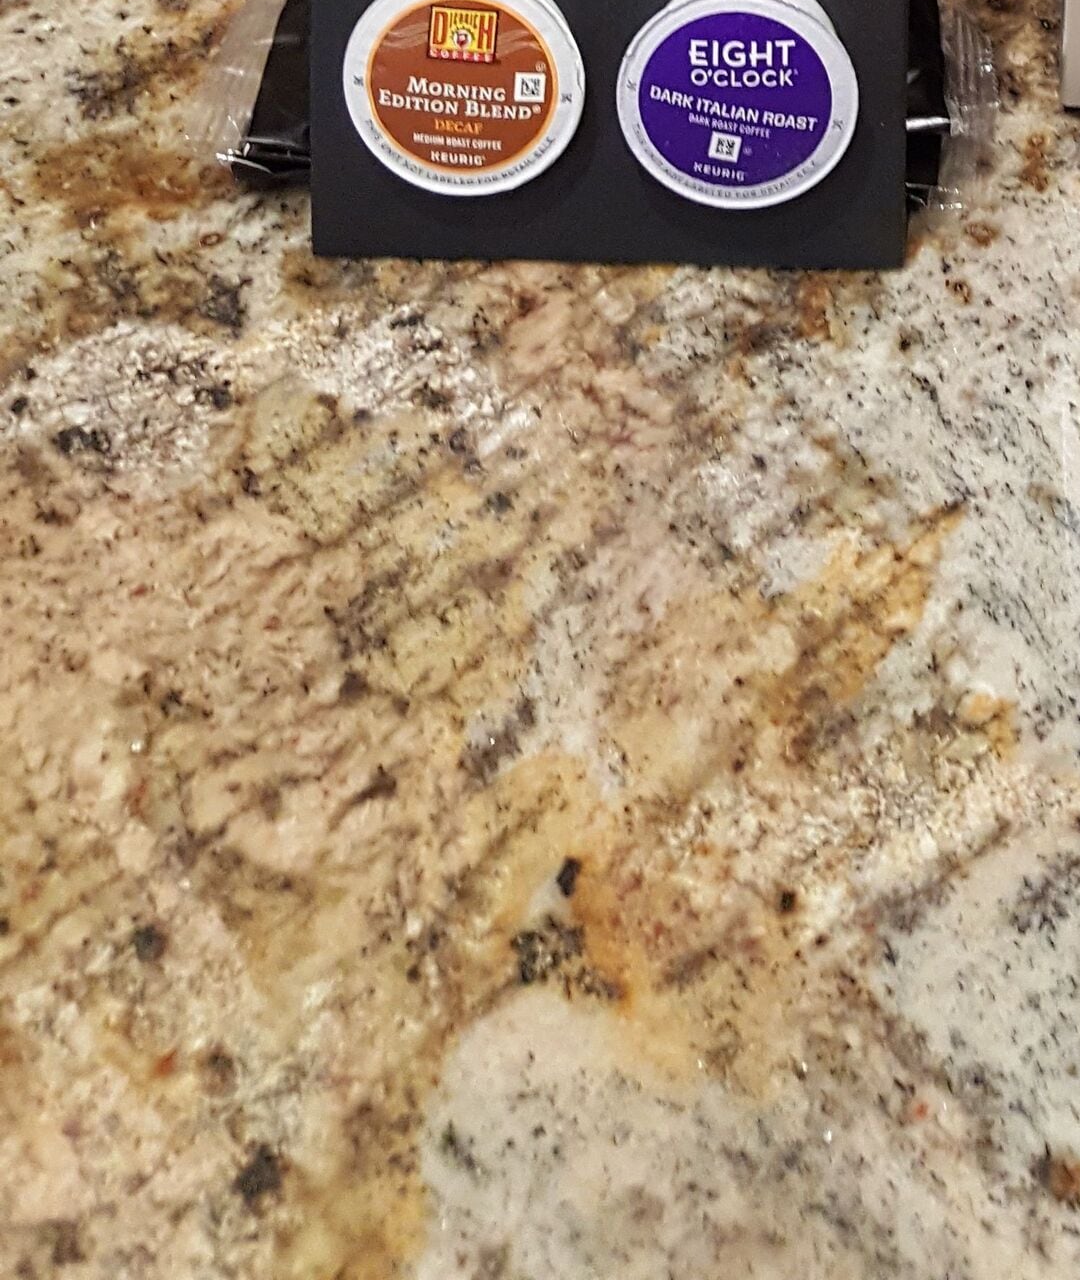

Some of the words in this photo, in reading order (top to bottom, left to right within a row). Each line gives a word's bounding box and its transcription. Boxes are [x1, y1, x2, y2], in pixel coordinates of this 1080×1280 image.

[429, 48, 493, 63] COFFEE
[689, 39, 795, 67] EIGHT
[407, 76, 505, 101] MORNING
[691, 69, 794, 88] O'CLOCK
[379, 89, 458, 115] EDITION
[650, 85, 694, 109] DARK
[696, 97, 759, 124] ITALIAN
[762, 111, 817, 132] ROAST
[434, 120, 483, 134] DECAF
[689, 112, 710, 126] DARK
[711, 117, 737, 132] ROAST
[739, 123, 771, 139] COFFEE
[413, 132, 445, 145] MEDIUM
[446, 135, 470, 148] ROAST
[472, 138, 502, 151] COFFEE
[430, 151, 483, 166] KEURIG
[694, 161, 744, 181] KEURIG
